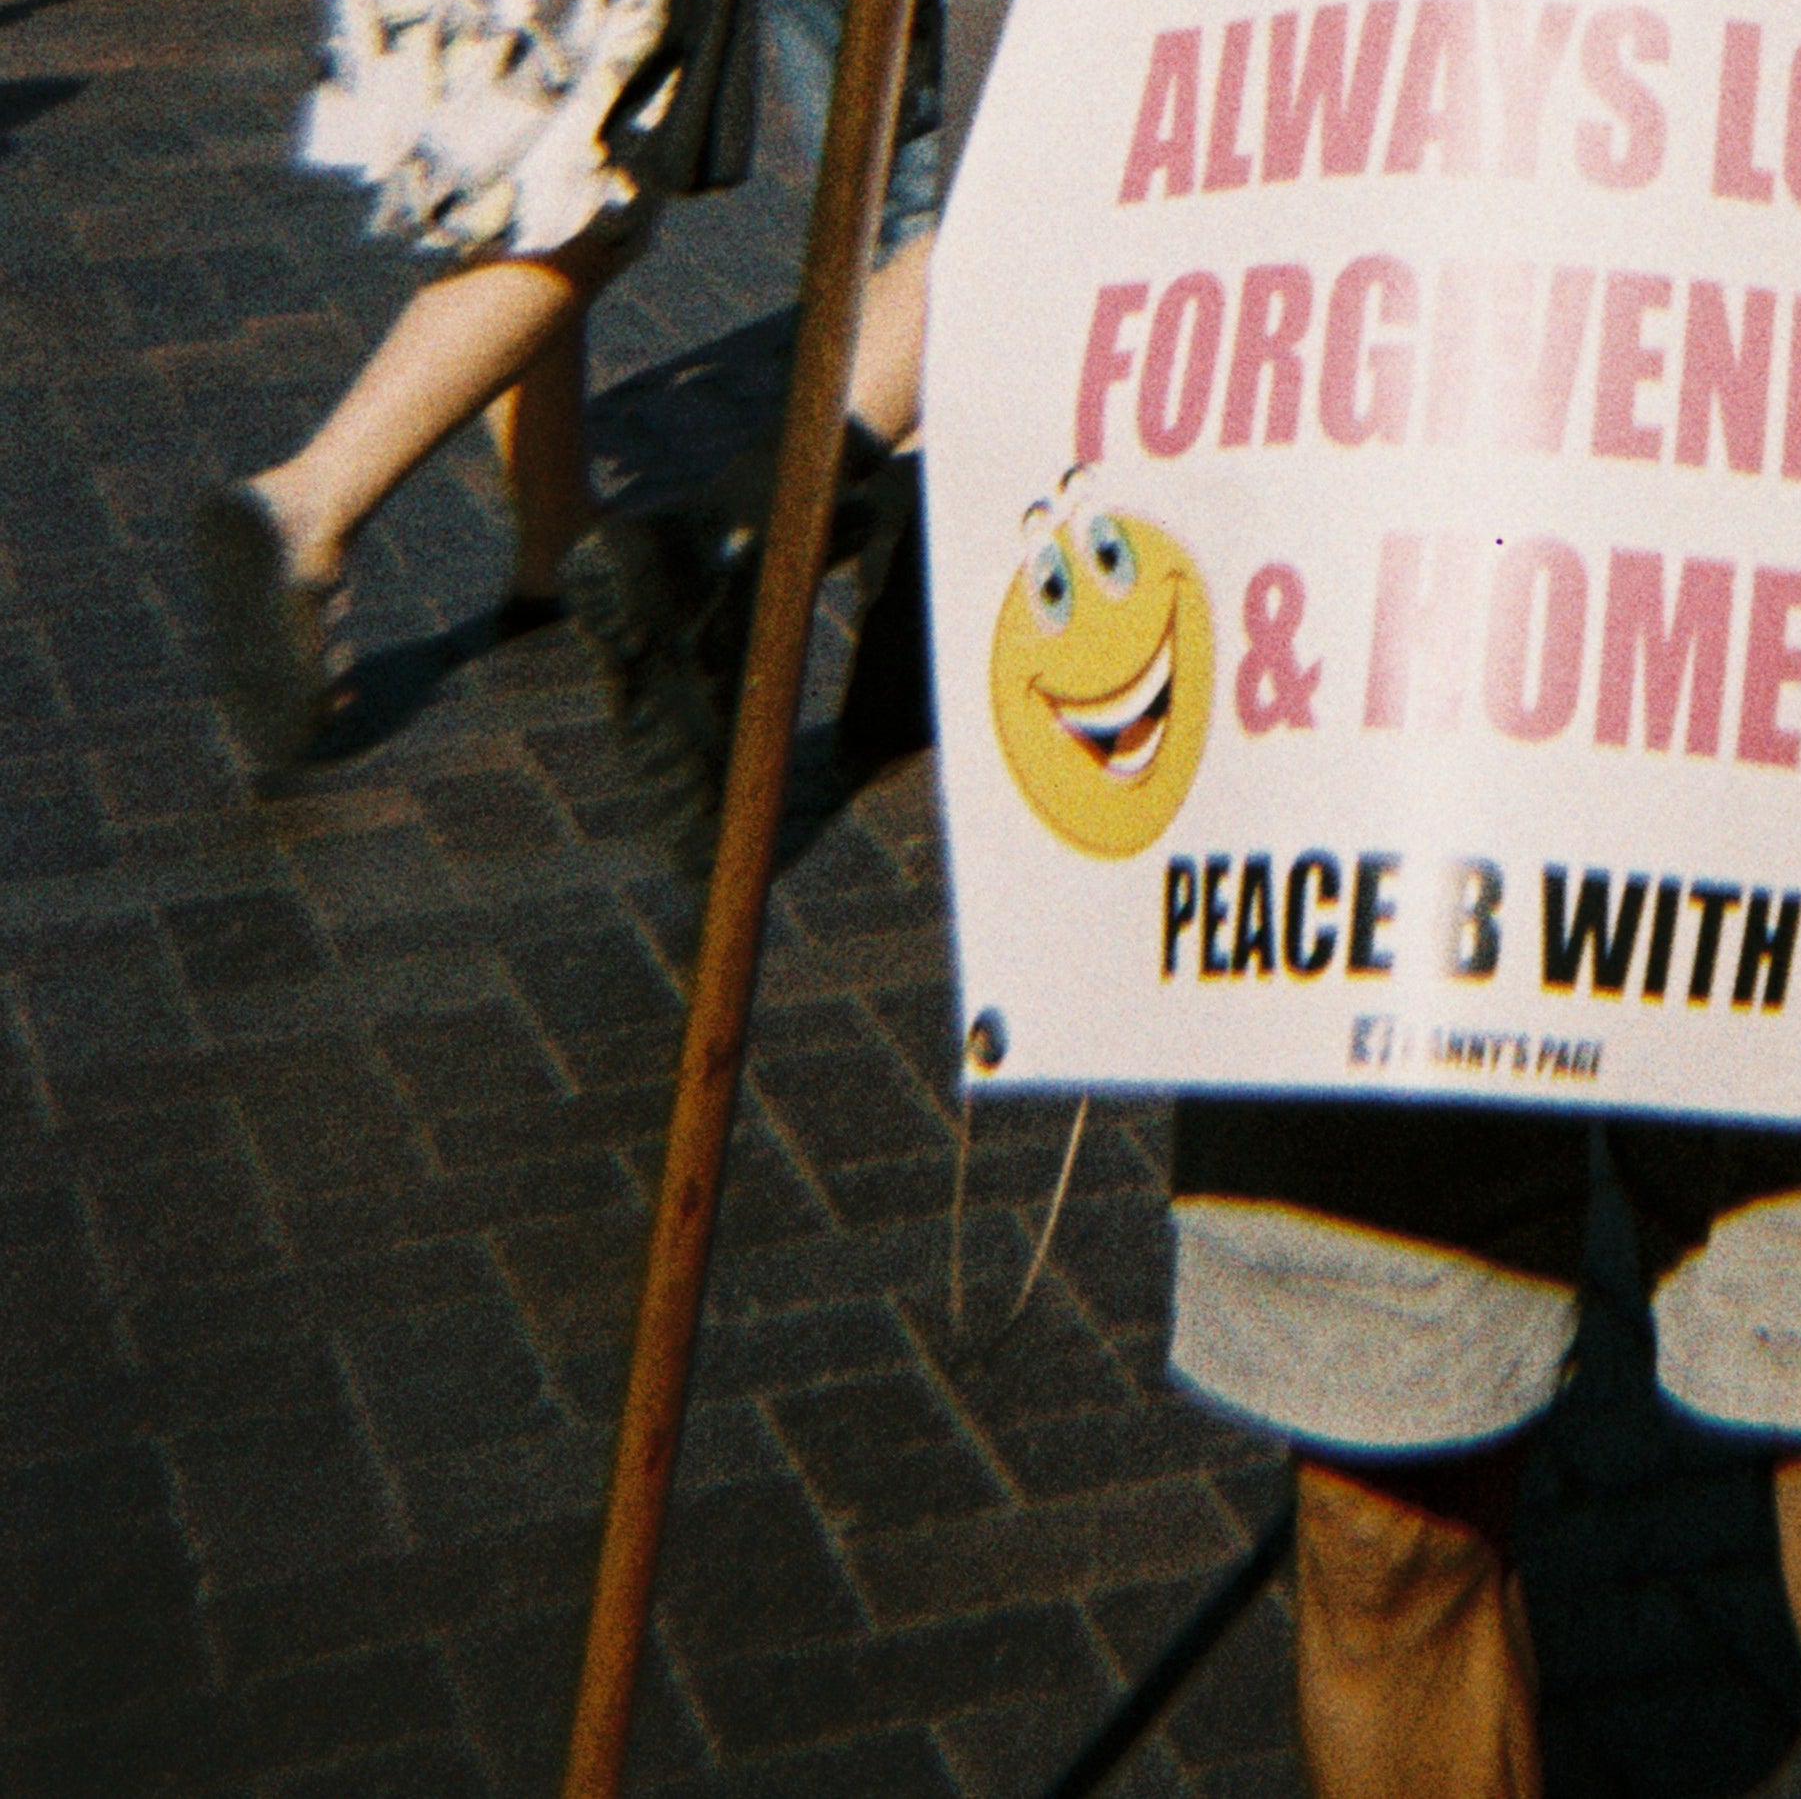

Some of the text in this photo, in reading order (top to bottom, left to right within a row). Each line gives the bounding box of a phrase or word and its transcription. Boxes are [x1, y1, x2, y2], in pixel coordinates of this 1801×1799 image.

[1232, 561, 1323, 737] &
[1158, 850, 1402, 983] PEACE
[1434, 855, 1506, 982] B
